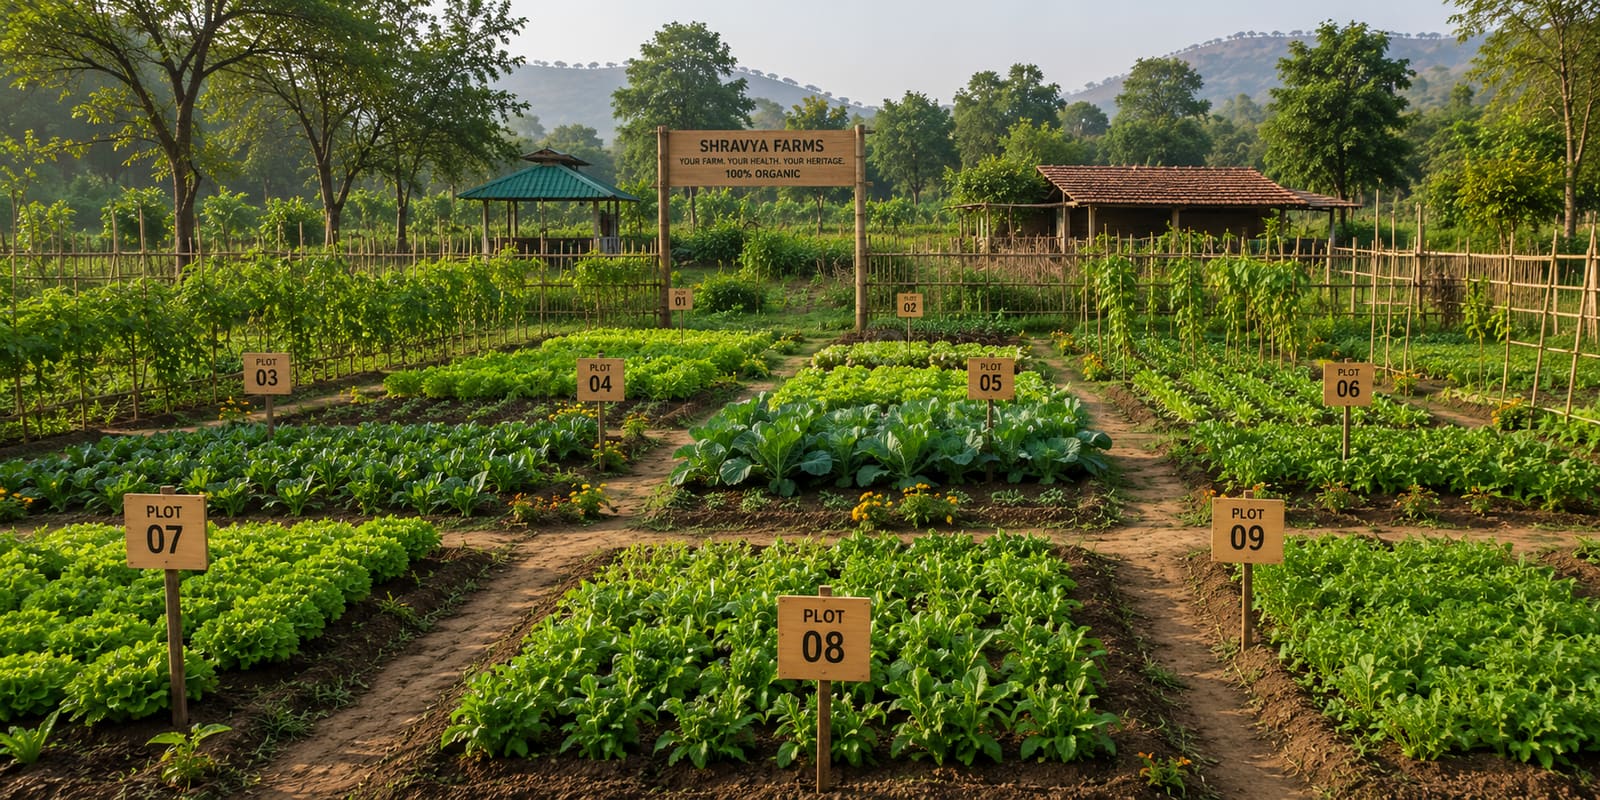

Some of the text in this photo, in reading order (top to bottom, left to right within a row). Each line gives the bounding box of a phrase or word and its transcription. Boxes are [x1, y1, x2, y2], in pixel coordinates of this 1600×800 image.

[699, 139, 825, 153] SHRAVYA FARMS
[679, 157, 846, 165] YOUR FARM. YOUR HEALTH. YOUR HERITAGE.
[726, 169, 801, 178] 100% ORGANIC
[675, 296, 686, 306] 01
[903, 302, 917, 312] 02
[256, 358, 277, 367] PLOT
[589, 363, 611, 372] PLOT
[980, 362, 1002, 371] PLOT
[255, 368, 278, 387] 03
[1337, 368, 1361, 377] PLOT
[589, 375, 612, 393] 04
[979, 374, 1002, 392] 05
[1336, 379, 1361, 398] 06
[146, 504, 183, 519] PLOT
[1231, 507, 1265, 520] PLOT
[146, 524, 183, 555] 07
[1230, 524, 1265, 552] 09
[803, 608, 846, 624] PLOT
[802, 630, 845, 664] 08
